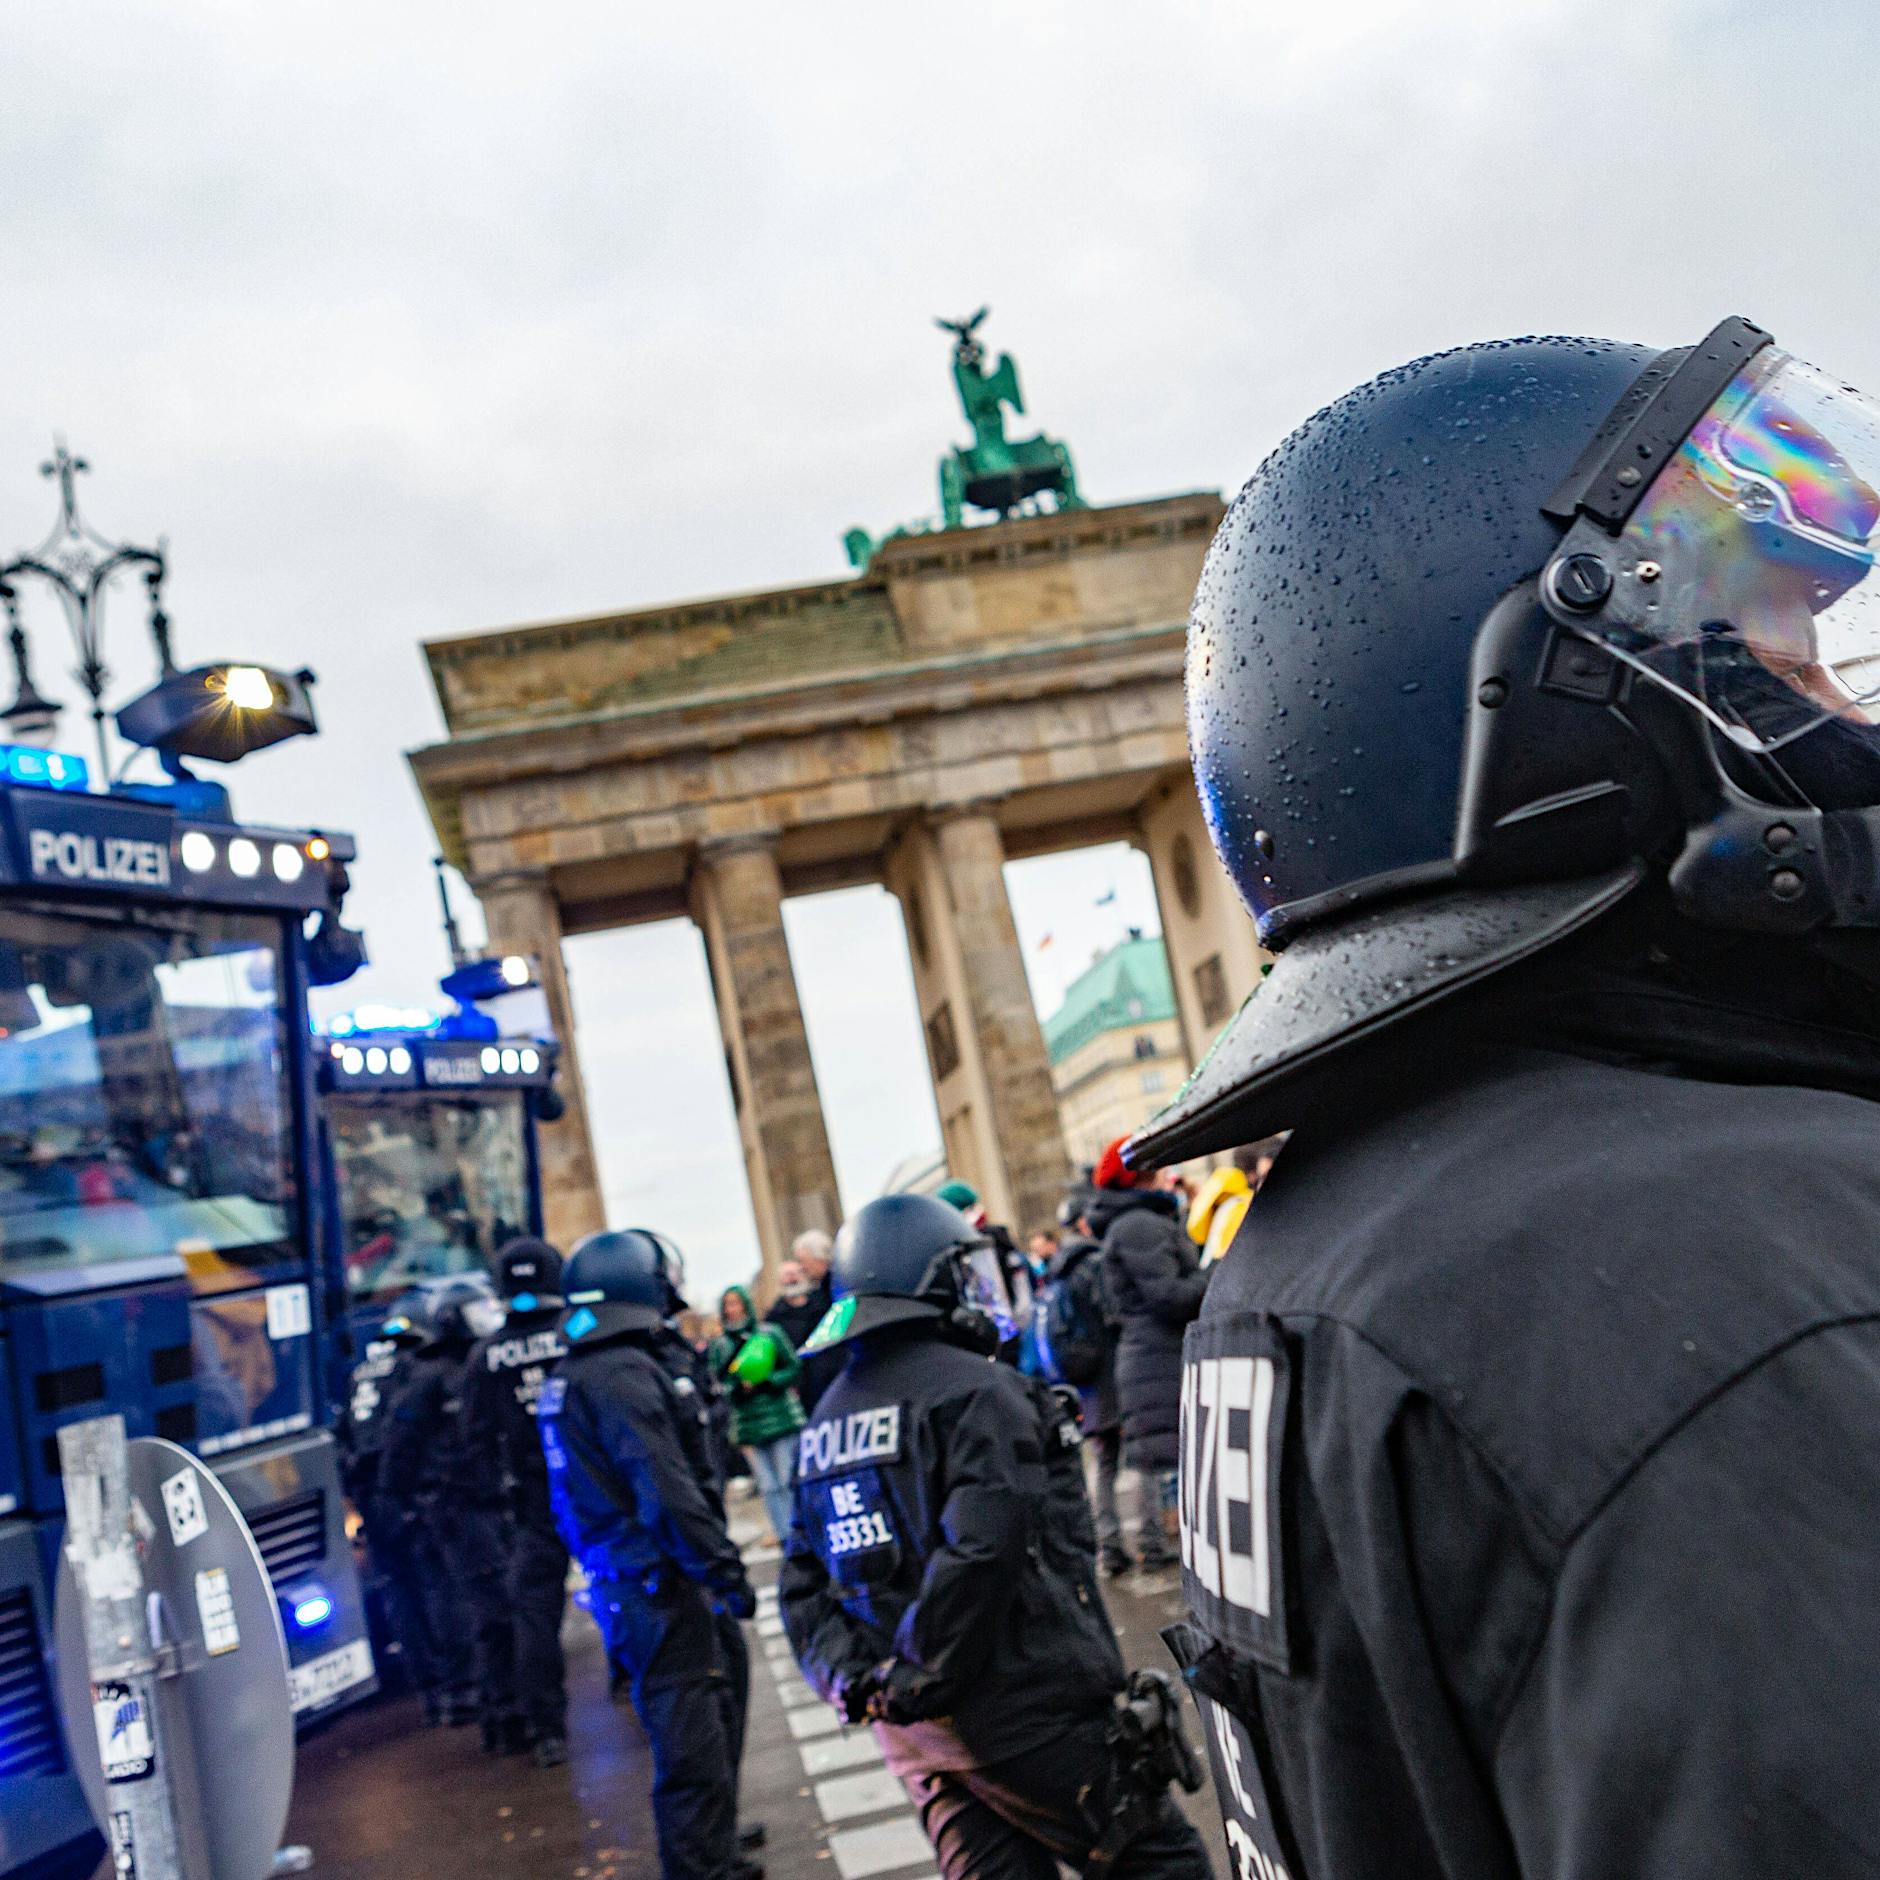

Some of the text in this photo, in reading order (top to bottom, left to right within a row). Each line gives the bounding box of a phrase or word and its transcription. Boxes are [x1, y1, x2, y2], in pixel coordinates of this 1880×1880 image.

[30, 829, 170, 885] POLIZEI
[798, 1406, 900, 1477] POLIZEI
[830, 1481, 865, 1517] BE
